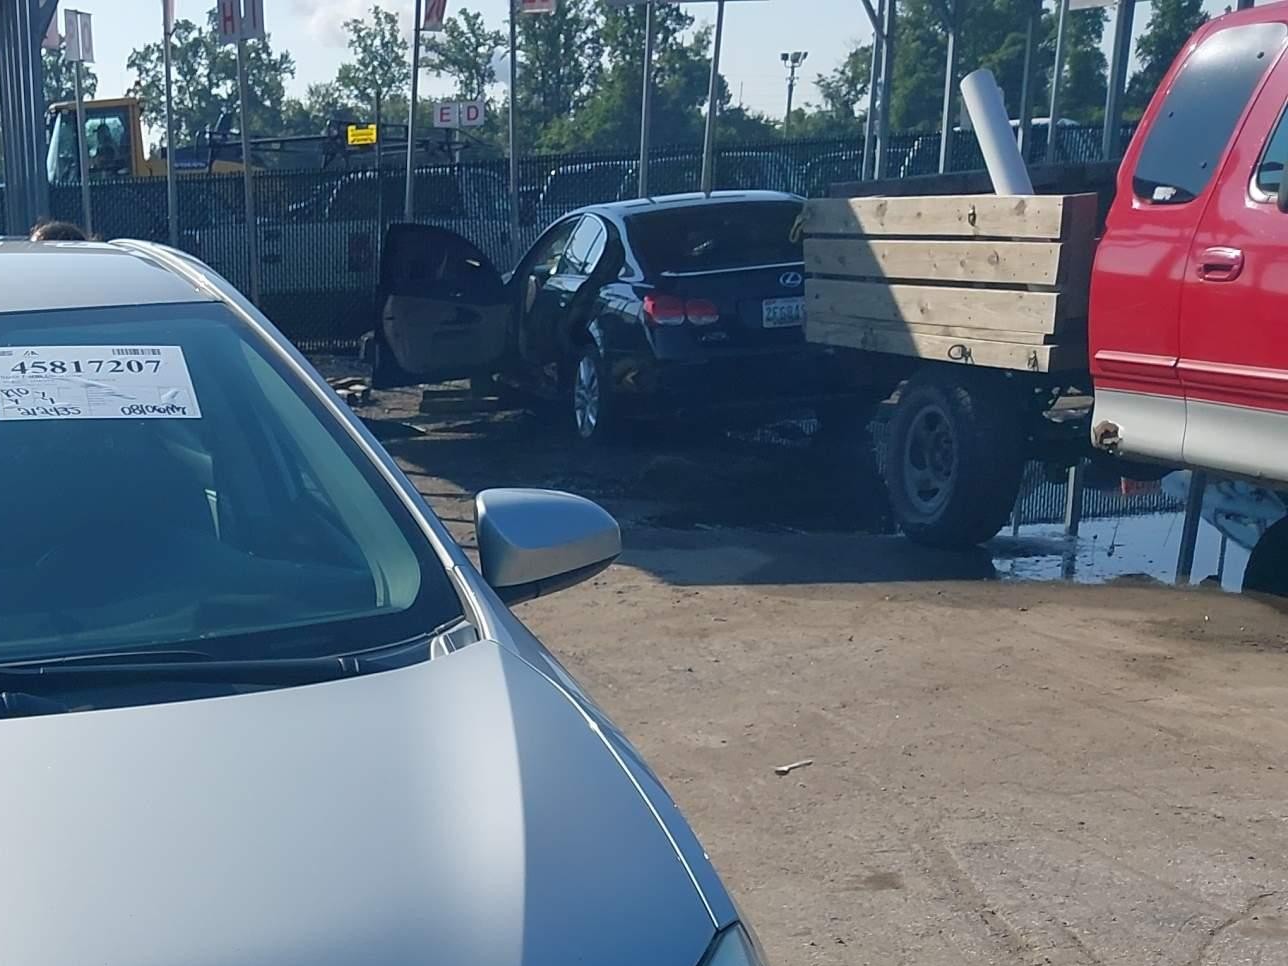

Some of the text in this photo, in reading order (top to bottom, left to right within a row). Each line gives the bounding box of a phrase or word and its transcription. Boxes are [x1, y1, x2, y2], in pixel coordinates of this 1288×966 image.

[439, 106, 452, 123] E
[466, 105, 480, 121] D
[11, 360, 161, 375] 45817207
